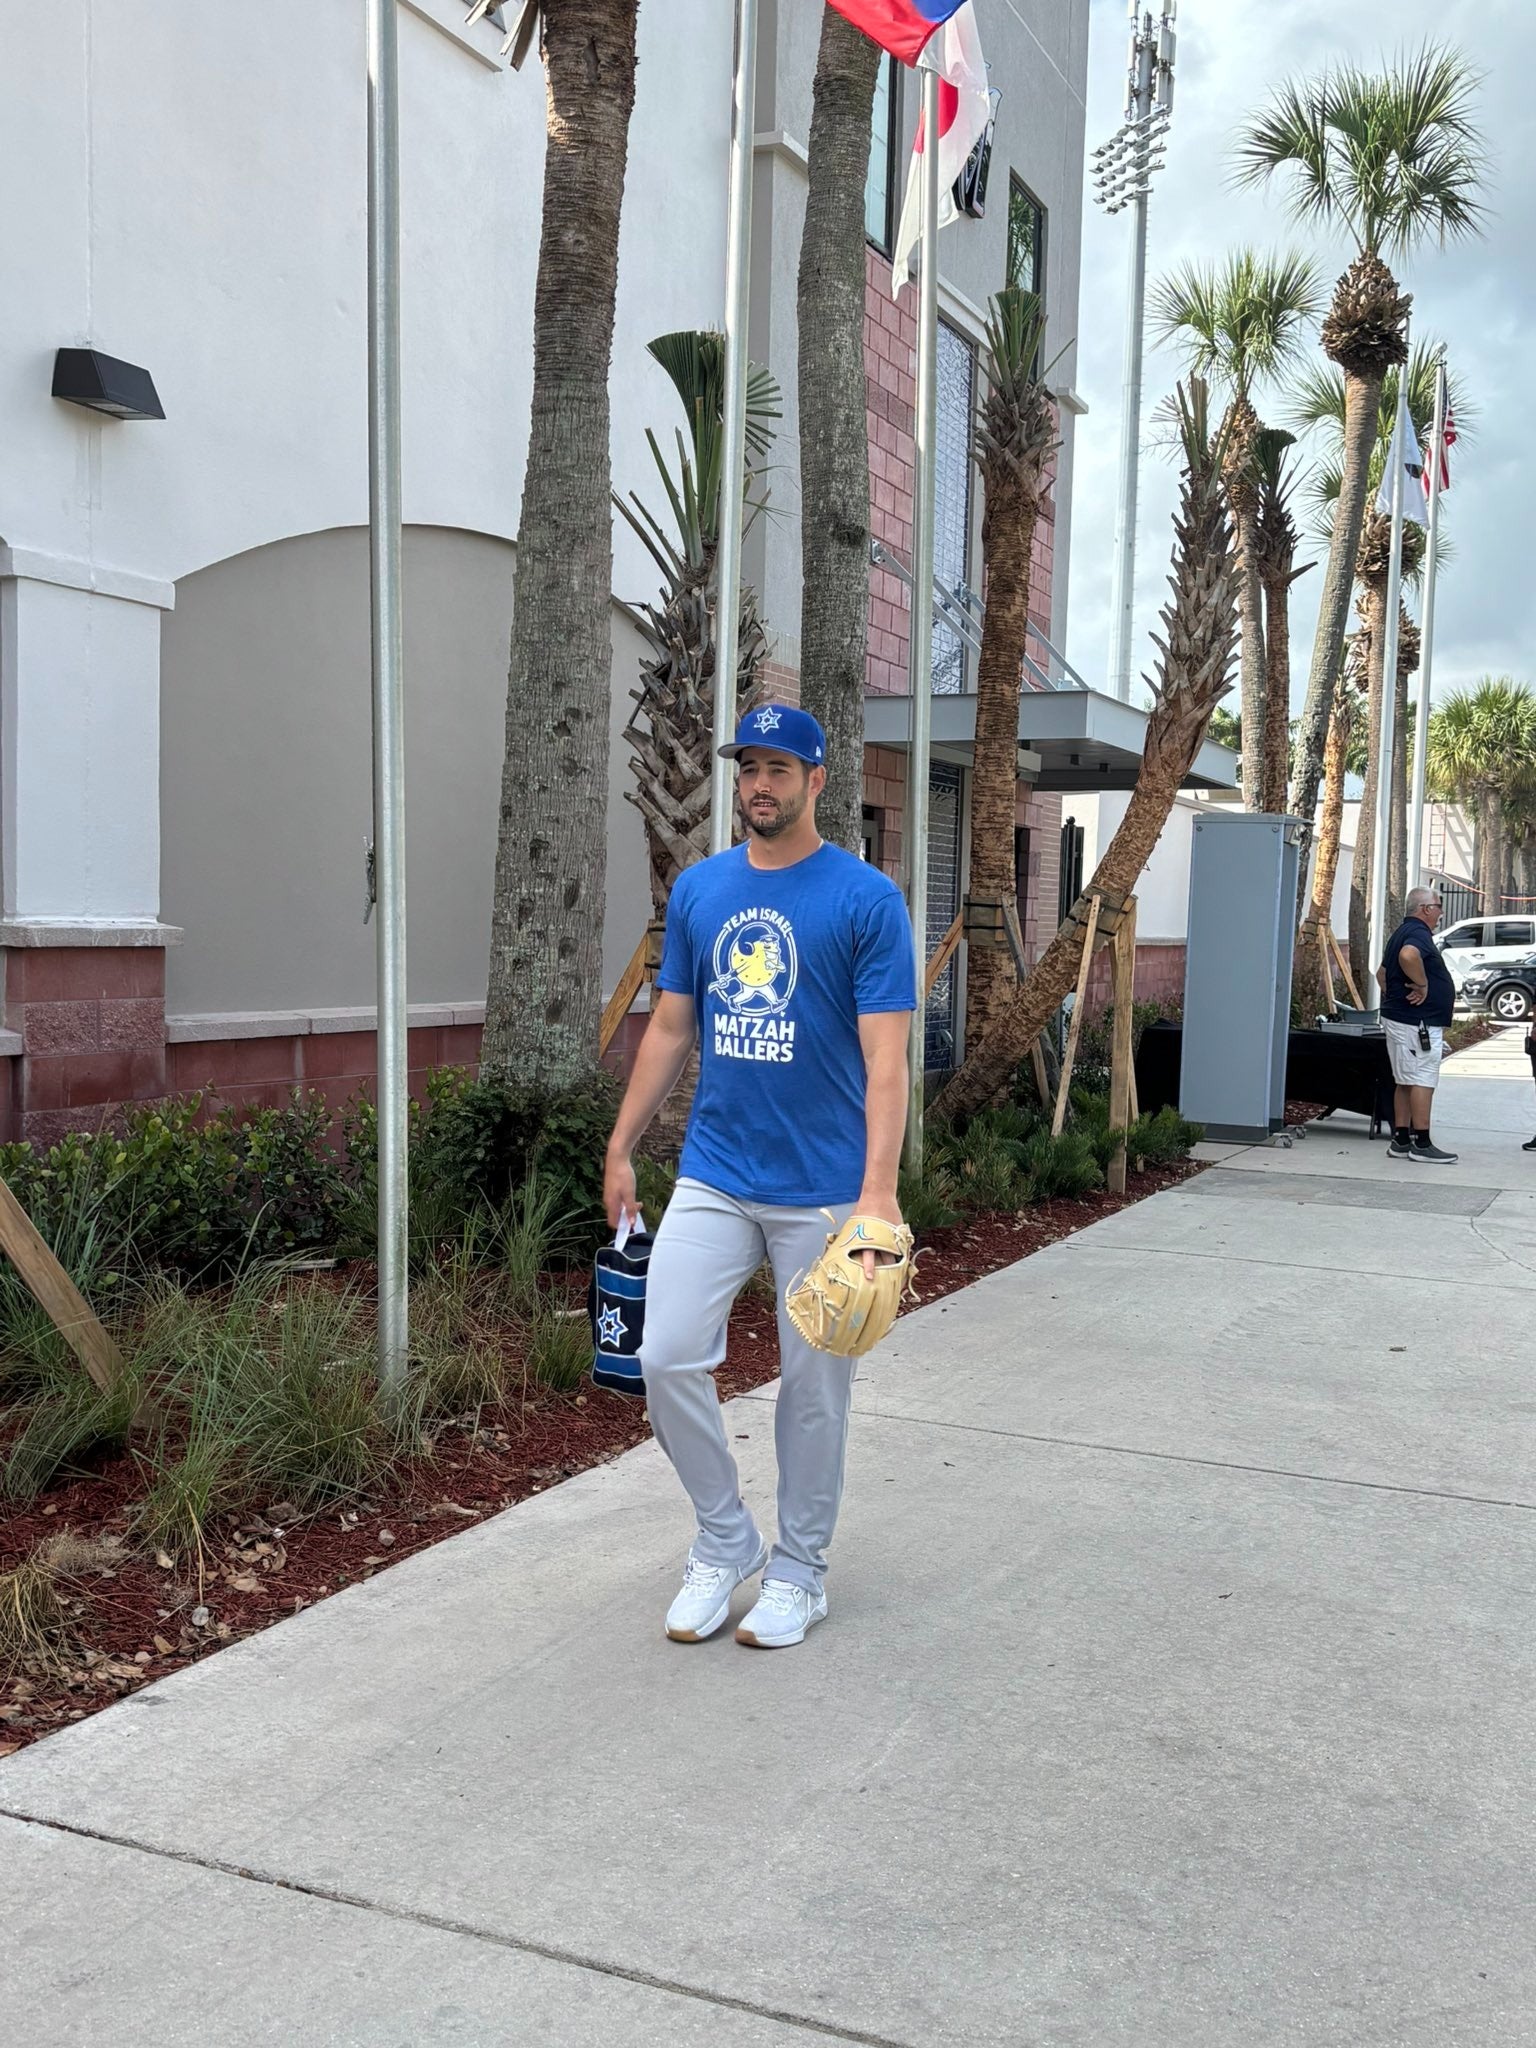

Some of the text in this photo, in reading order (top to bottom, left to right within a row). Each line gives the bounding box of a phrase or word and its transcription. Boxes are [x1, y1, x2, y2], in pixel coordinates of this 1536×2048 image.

[723, 907, 793, 938] TEAM ISRAEL
[714, 1013, 795, 1041] MATZAH
[714, 1035, 794, 1063] BALLERS
